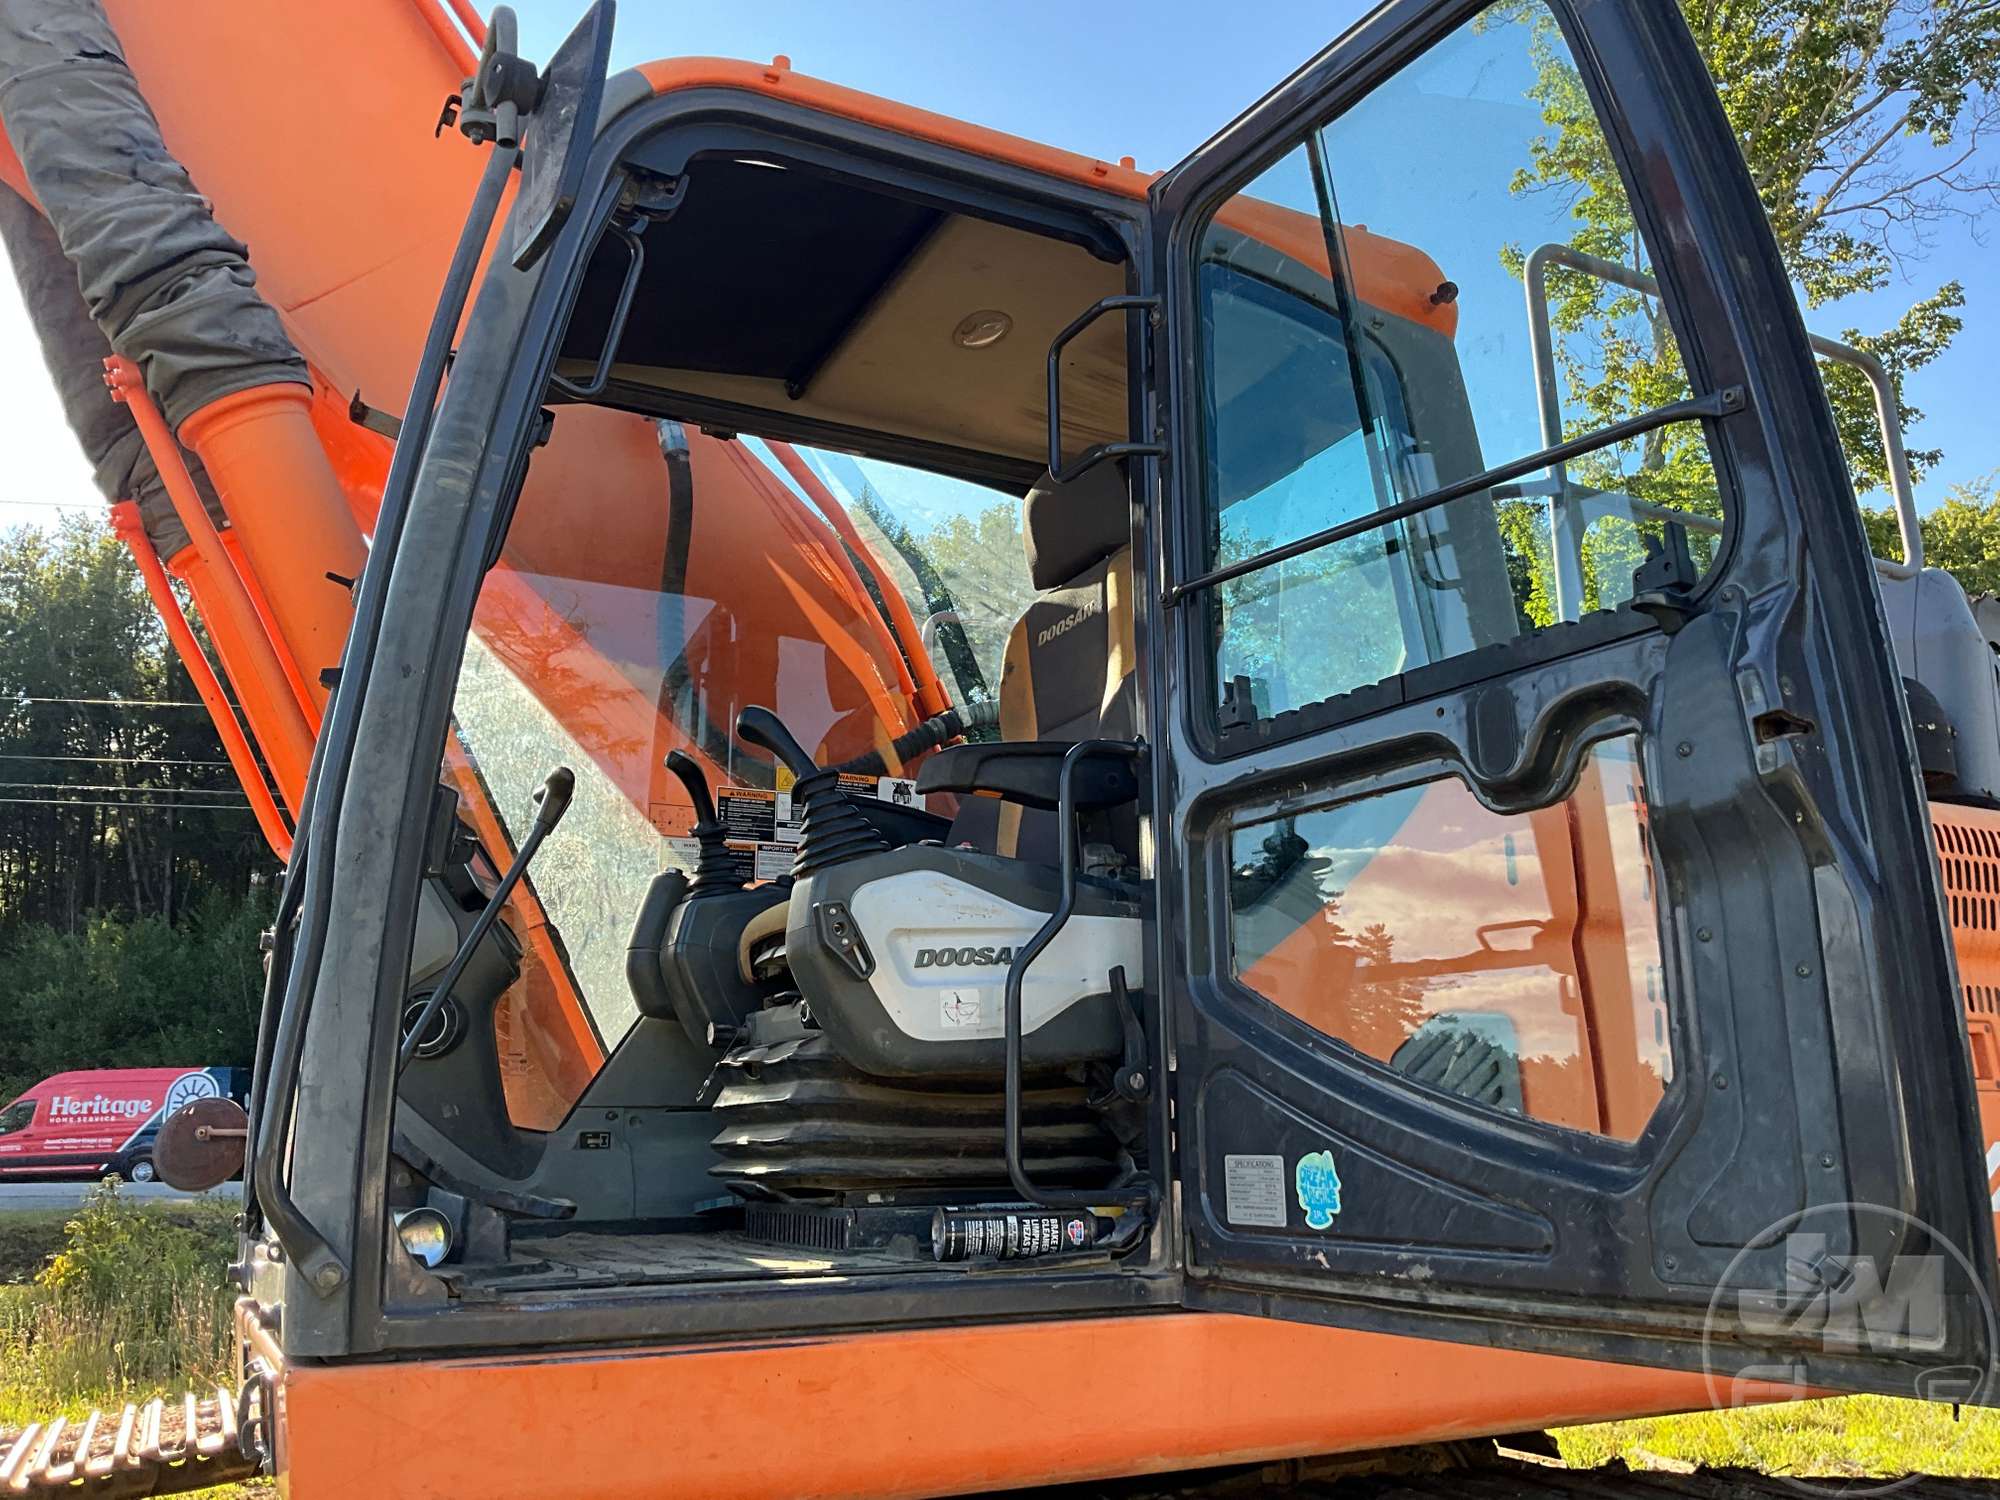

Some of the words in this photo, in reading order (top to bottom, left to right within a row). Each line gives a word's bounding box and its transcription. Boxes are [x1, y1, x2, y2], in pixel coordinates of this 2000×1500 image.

[1038, 599, 1096, 647] DOOSAN
[736, 791, 768, 799] WARNING
[50, 1094, 152, 1118] Heritage
[77, 1115, 116, 1123] SERVICE
[1022, 1219, 1031, 1246] PIEZAS
[1049, 1218, 1059, 1245] BRAKE
